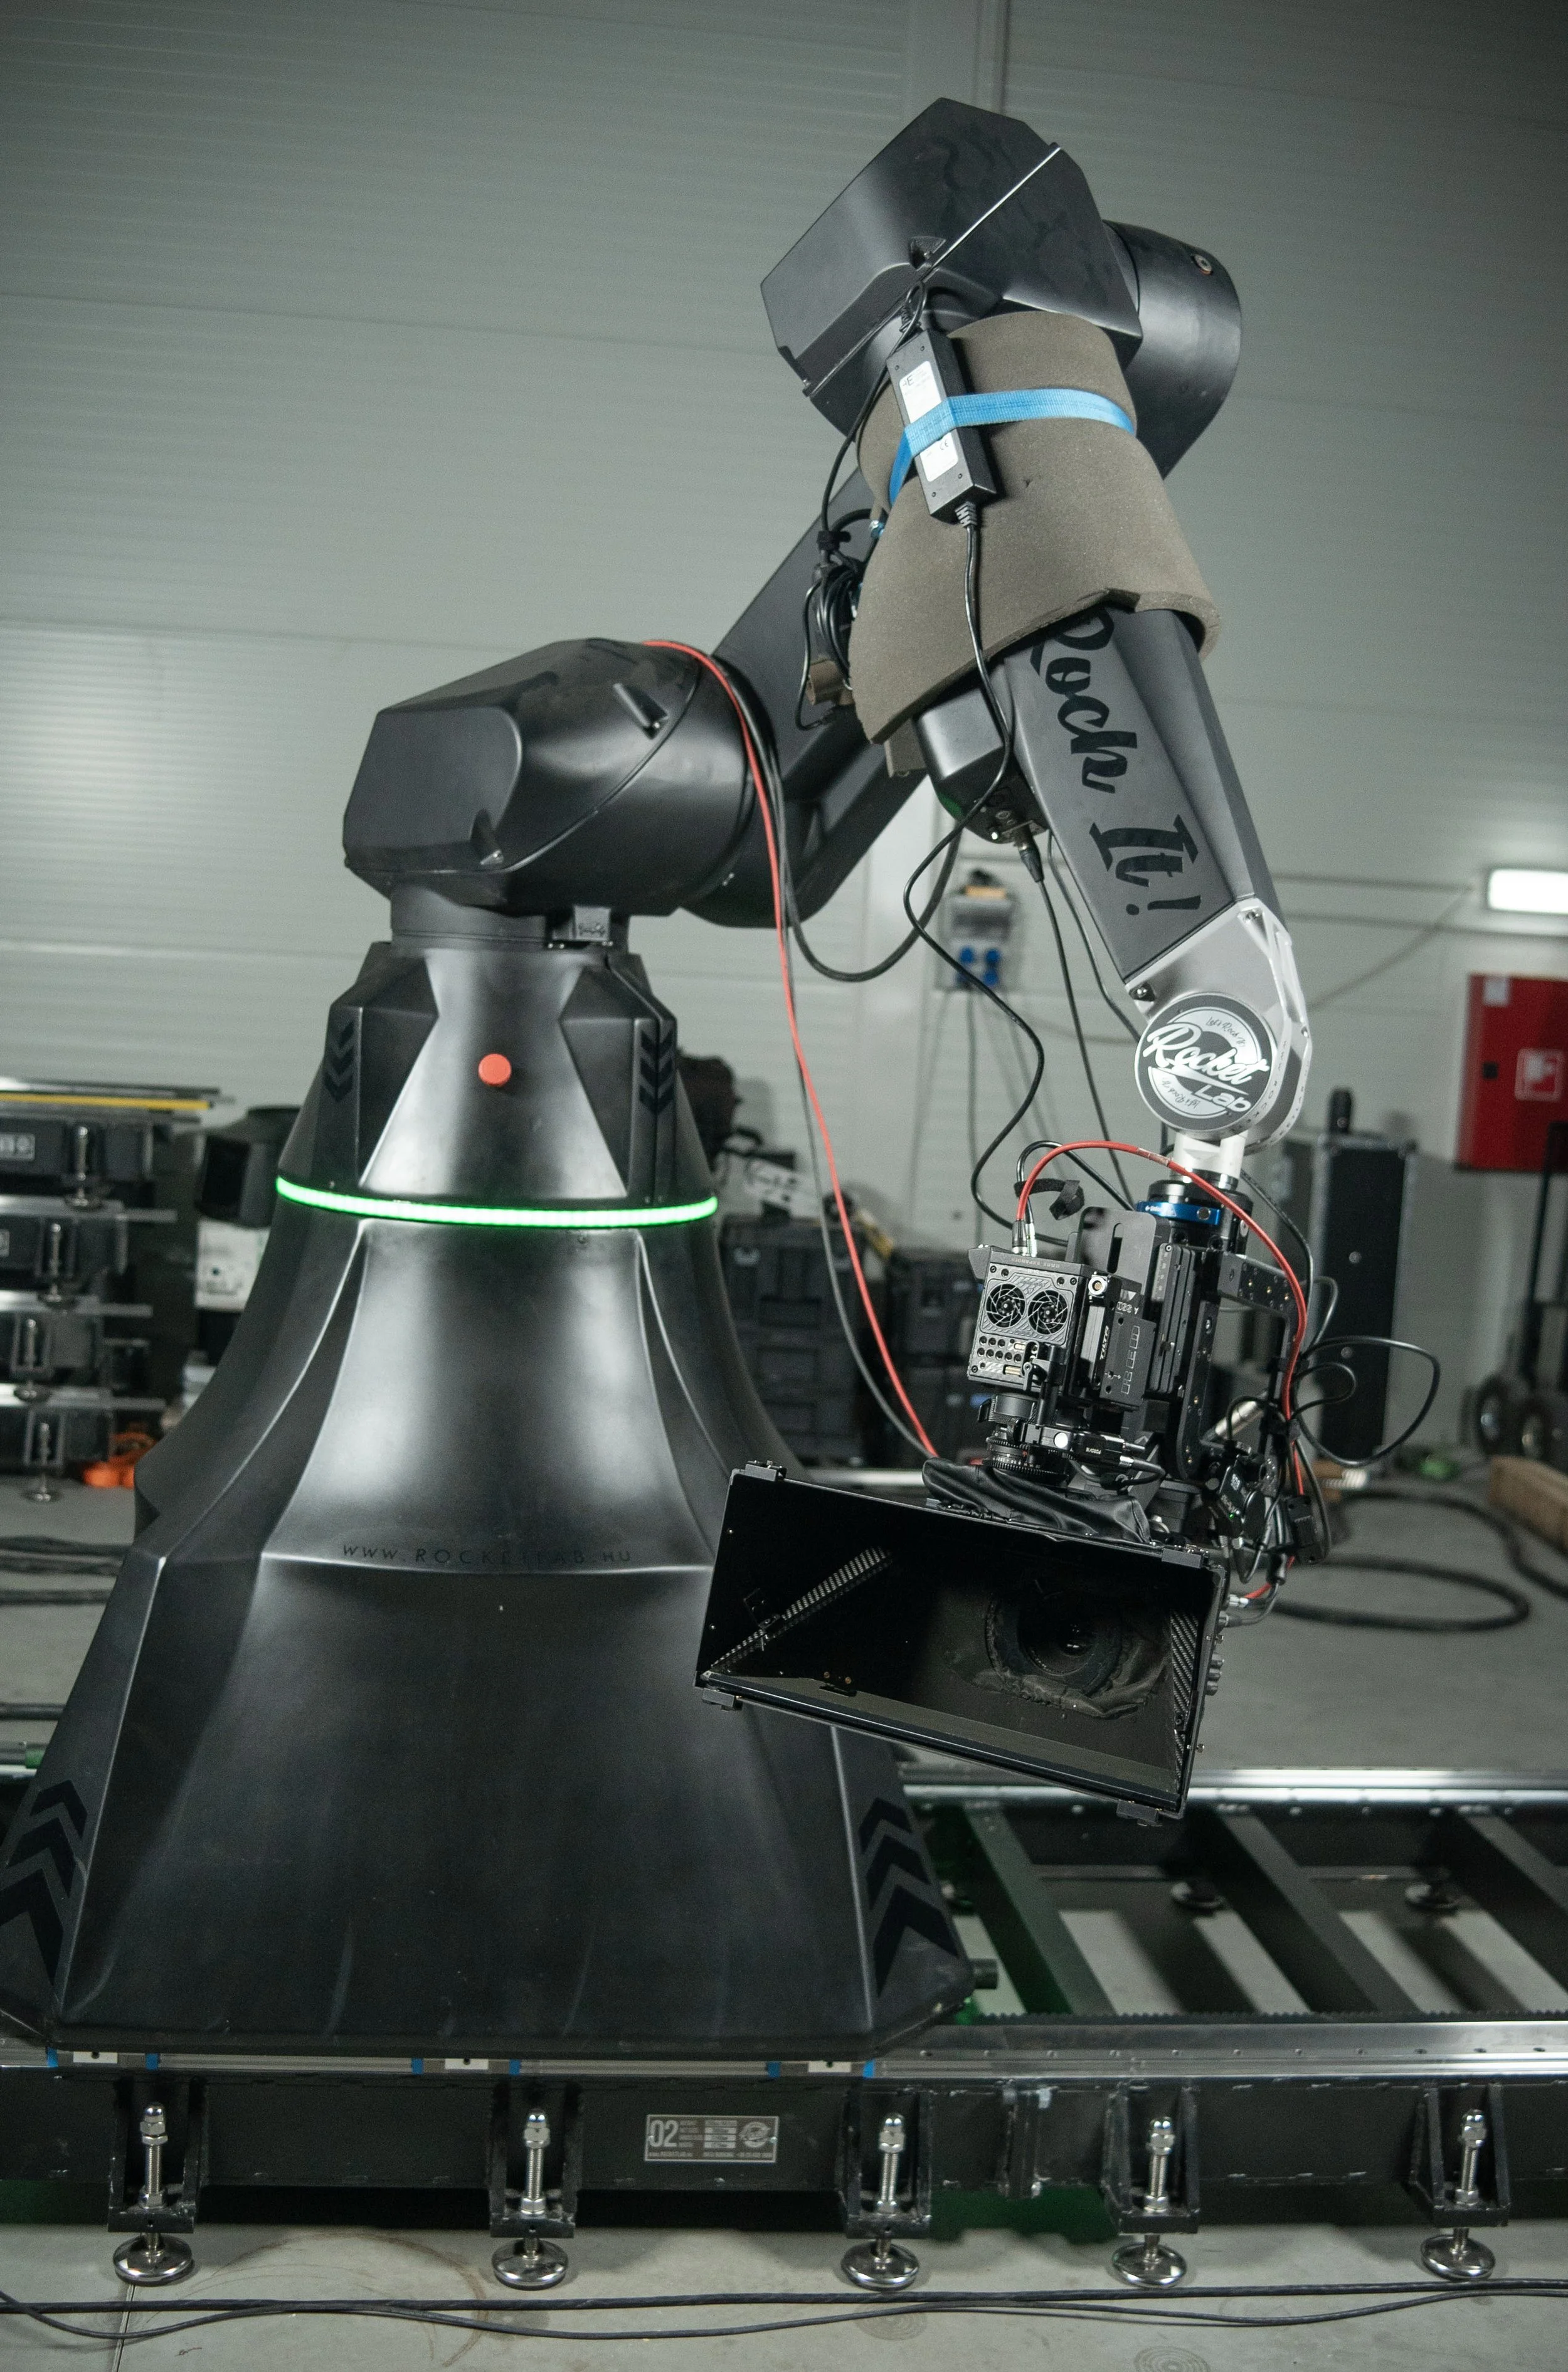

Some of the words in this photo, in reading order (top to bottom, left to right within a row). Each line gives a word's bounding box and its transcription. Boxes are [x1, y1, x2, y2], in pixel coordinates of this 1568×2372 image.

[1089, 815, 1201, 916] It!
[1142, 1022, 1270, 1085] Rocket
[1194, 1084, 1251, 1113] Lab
[649, 2119, 679, 2147] 02
